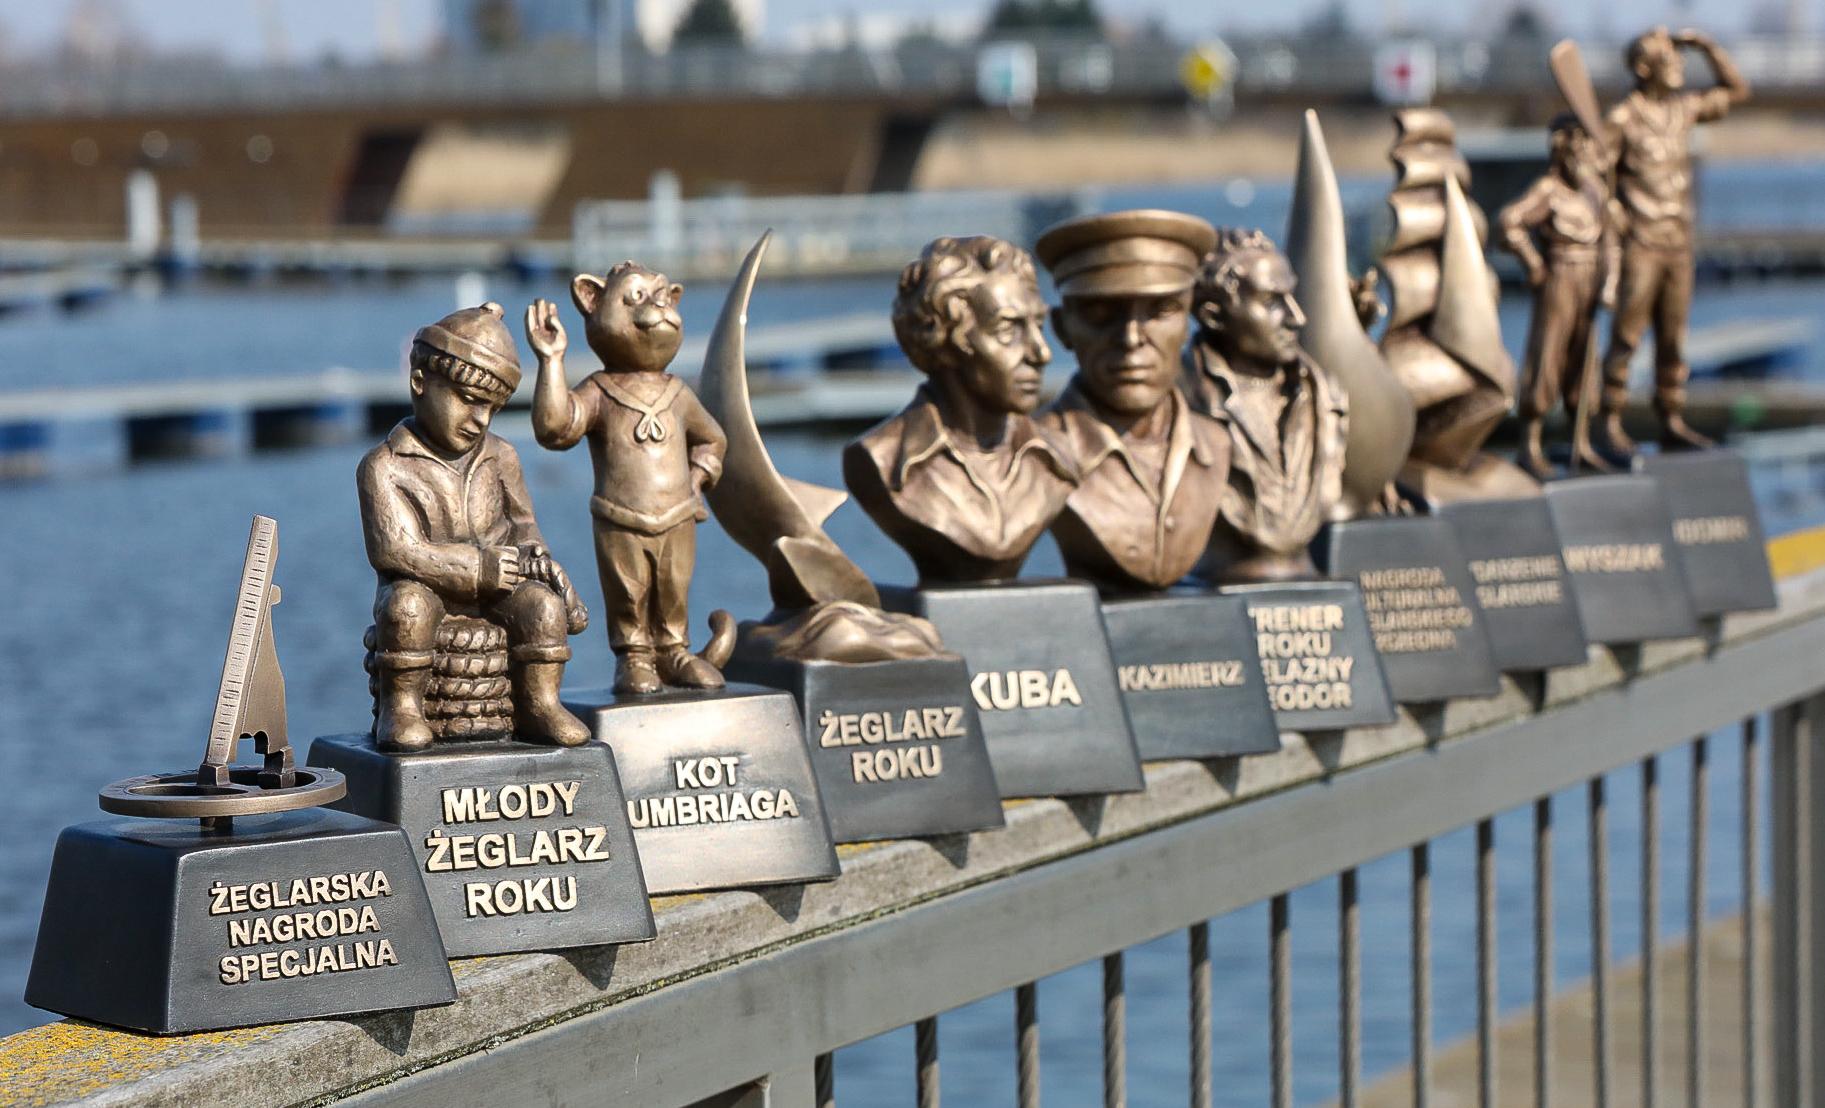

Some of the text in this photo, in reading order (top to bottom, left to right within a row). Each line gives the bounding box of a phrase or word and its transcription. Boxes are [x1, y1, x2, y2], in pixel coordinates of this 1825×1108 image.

[1257, 631, 1331, 659] ROKU
[970, 668, 1082, 710] KUBA
[1118, 660, 1245, 692] KAZIMIERZ
[819, 707, 966, 748] ŻEGLARZ
[674, 756, 739, 788] KOT
[852, 744, 943, 783] ROKU
[442, 781, 582, 824] MŁODY
[627, 789, 799, 828] UMBRIAGA
[425, 827, 610, 873] ŻEGLARZ
[208, 870, 393, 916] ŻEGLARSKA
[466, 876, 578, 917] ROKU
[229, 906, 380, 947] NAGRODA
[219, 939, 398, 985] SPECJALNA
